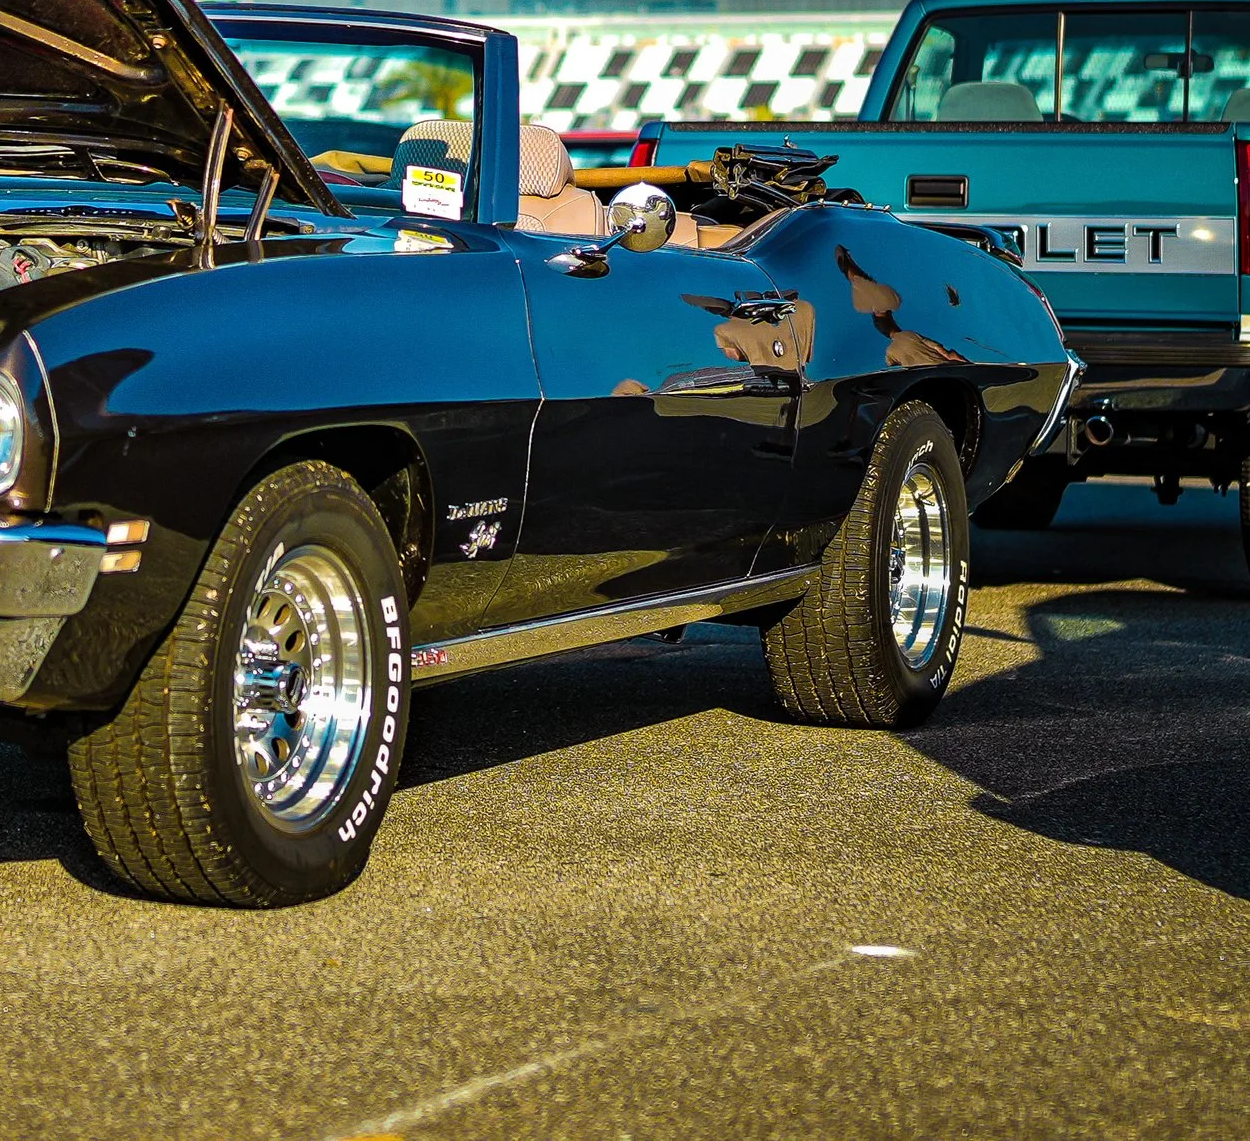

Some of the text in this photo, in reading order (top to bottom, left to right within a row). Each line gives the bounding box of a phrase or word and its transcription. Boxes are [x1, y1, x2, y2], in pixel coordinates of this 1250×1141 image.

[424, 171, 445, 183] 50
[930, 560, 967, 689] Radial T/A
[338, 595, 402, 843] BFGoodrich
